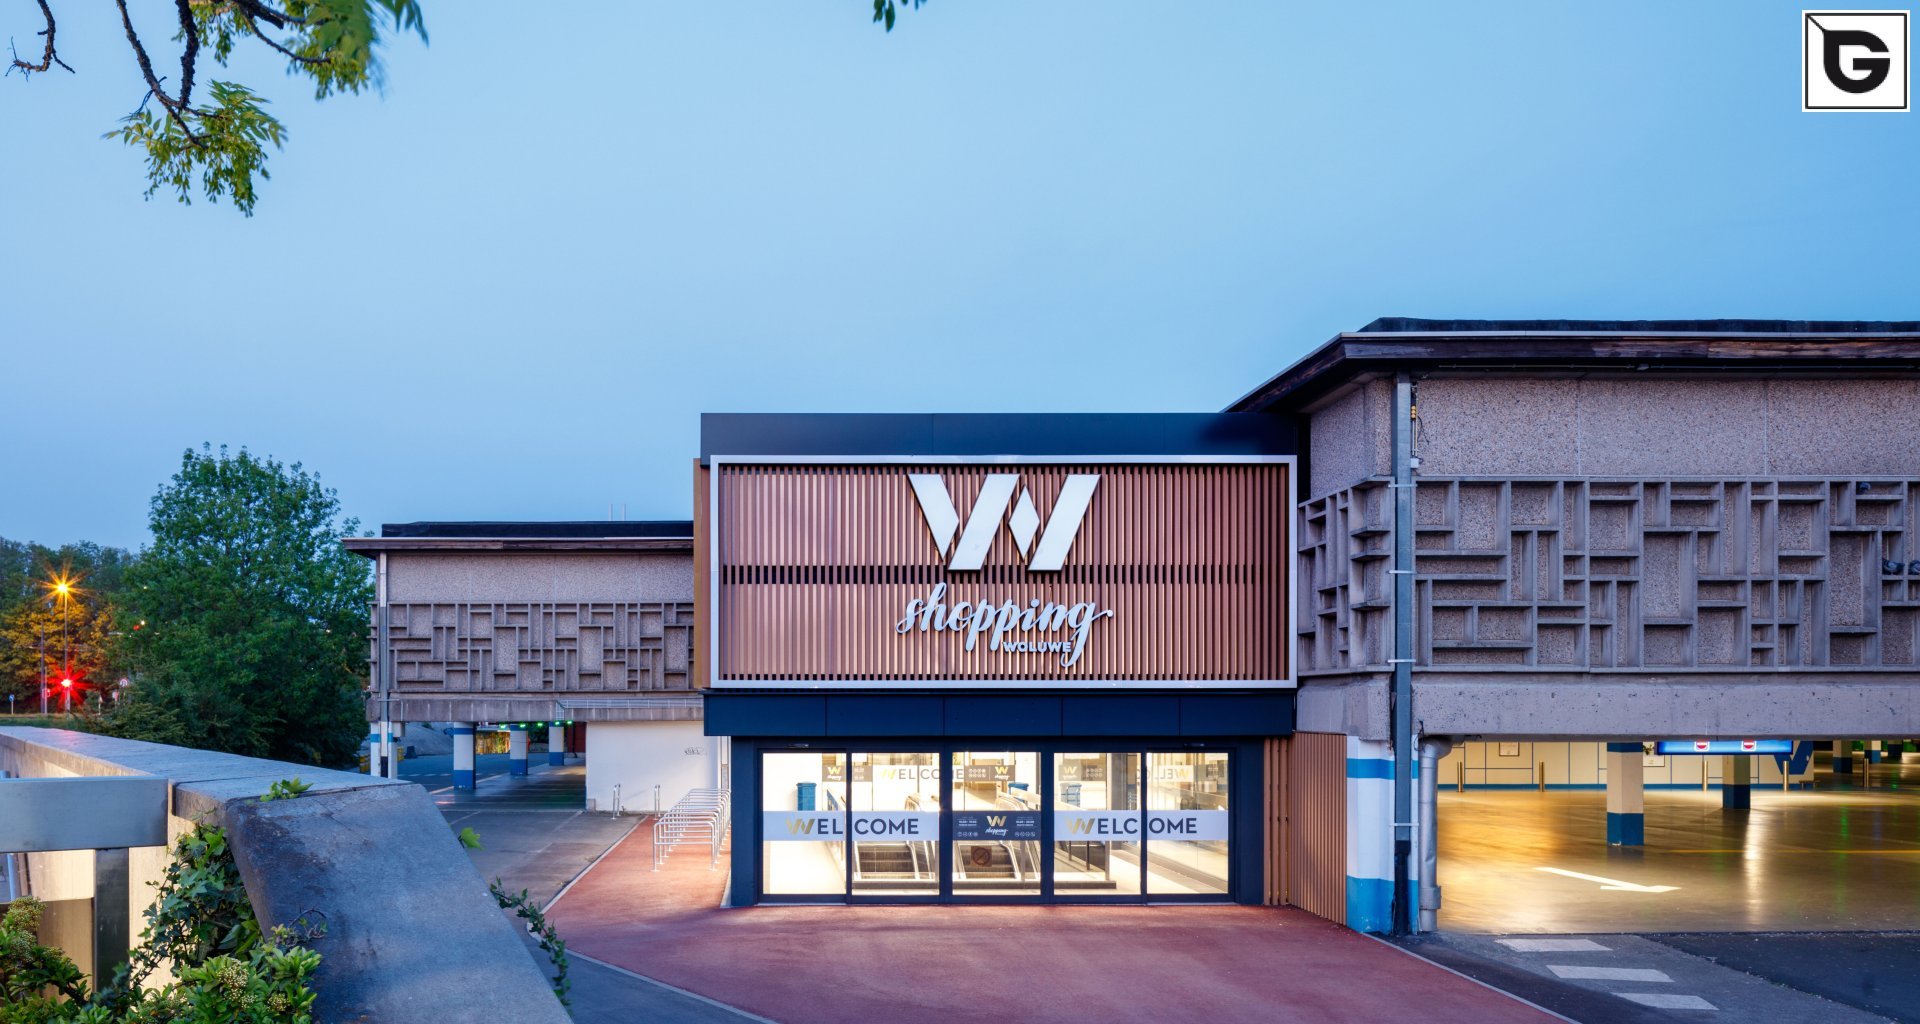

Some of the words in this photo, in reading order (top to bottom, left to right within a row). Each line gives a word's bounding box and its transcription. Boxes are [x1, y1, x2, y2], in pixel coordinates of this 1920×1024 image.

[896, 582, 1114, 668] shopping
[1003, 640, 1073, 653] WOLUWE
[786, 818, 919, 835] WELCOME
[1064, 817, 1198, 835] WELCOME
